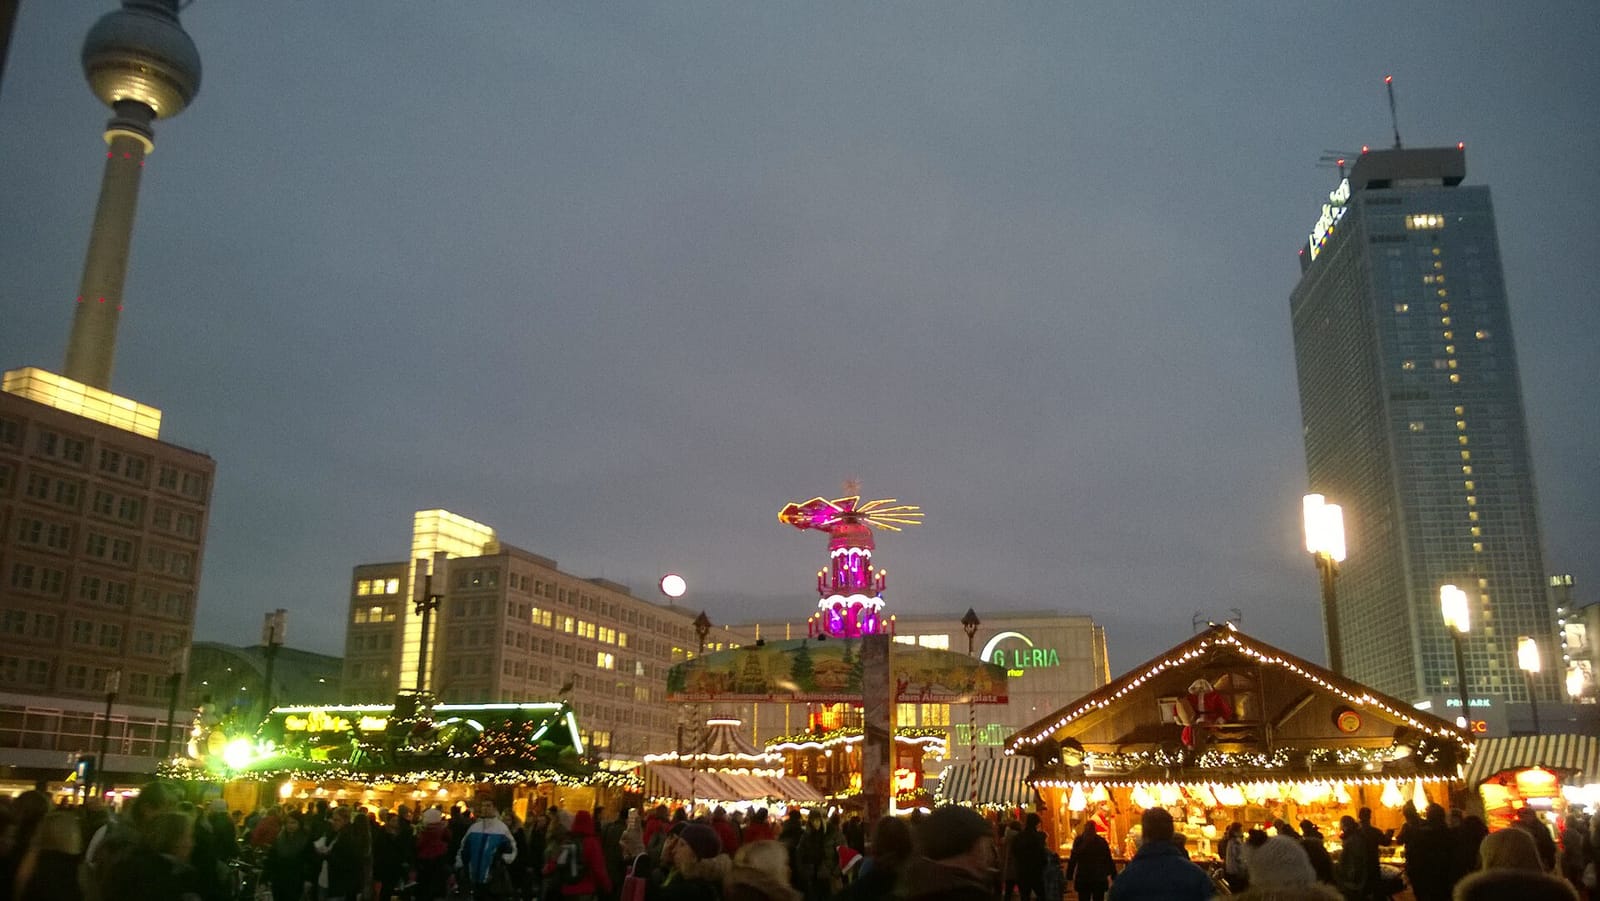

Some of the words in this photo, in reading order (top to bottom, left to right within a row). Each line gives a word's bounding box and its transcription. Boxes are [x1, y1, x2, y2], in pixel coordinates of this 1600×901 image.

[994, 649, 1060, 667] GLERIA
[898, 693, 920, 702] dem
[1446, 699, 1490, 707] PRIARK
